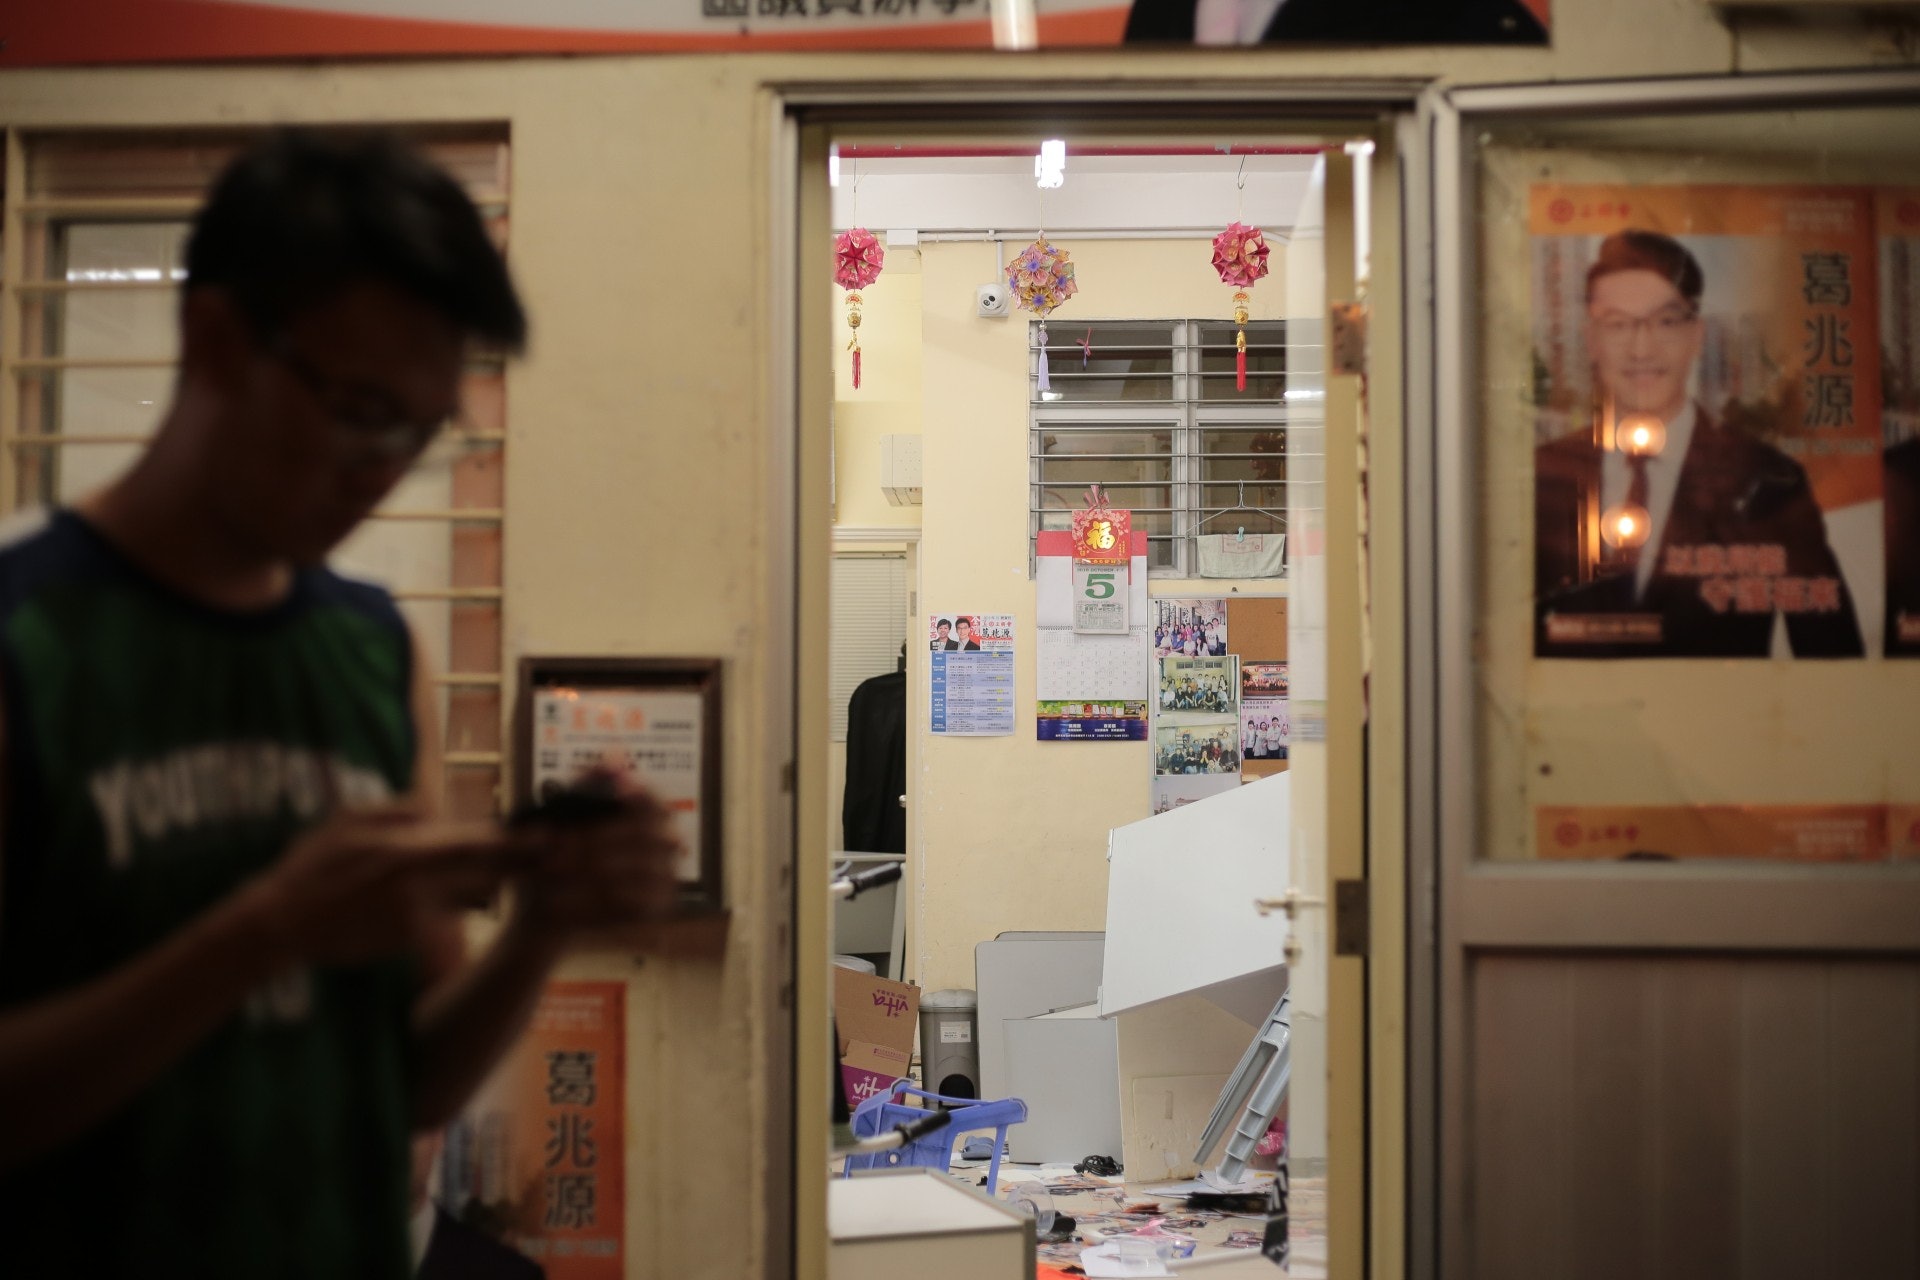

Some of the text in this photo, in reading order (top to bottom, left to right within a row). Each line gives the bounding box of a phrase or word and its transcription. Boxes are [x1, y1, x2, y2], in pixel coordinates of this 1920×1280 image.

[1801, 250, 1854, 428] 葛兆源
[1085, 520, 1116, 550] 福
[1085, 573, 1115, 599] 5
[872, 992, 909, 1018] vita
[853, 1075, 881, 1098] vit
[545, 1050, 598, 1230] 葛兆源
